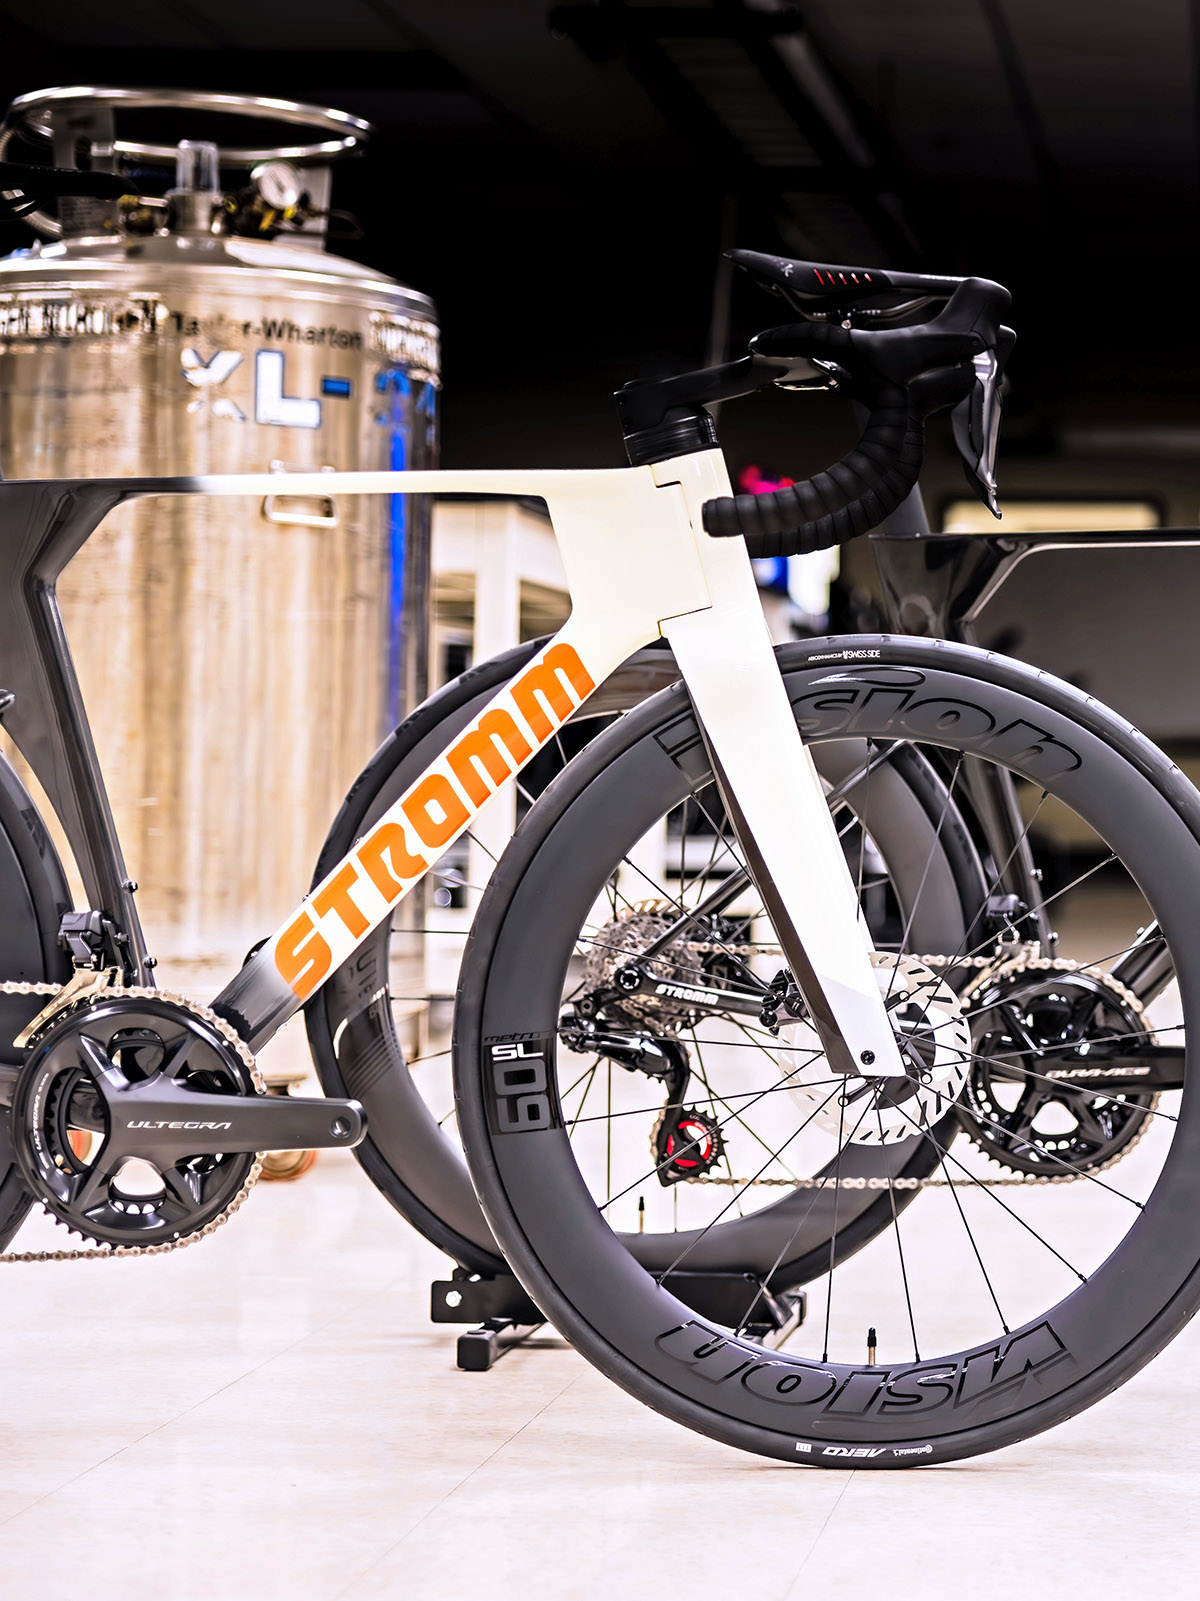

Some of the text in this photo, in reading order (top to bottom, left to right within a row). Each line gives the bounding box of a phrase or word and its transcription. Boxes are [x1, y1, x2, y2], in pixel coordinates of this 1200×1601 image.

[275, 643, 596, 1000] STROMM
[655, 984, 719, 1005] STROMM
[492, 1043, 543, 1061] SL
[127, 1121, 232, 1129] ULTEGRA
[822, 1446, 887, 1457] AERO
